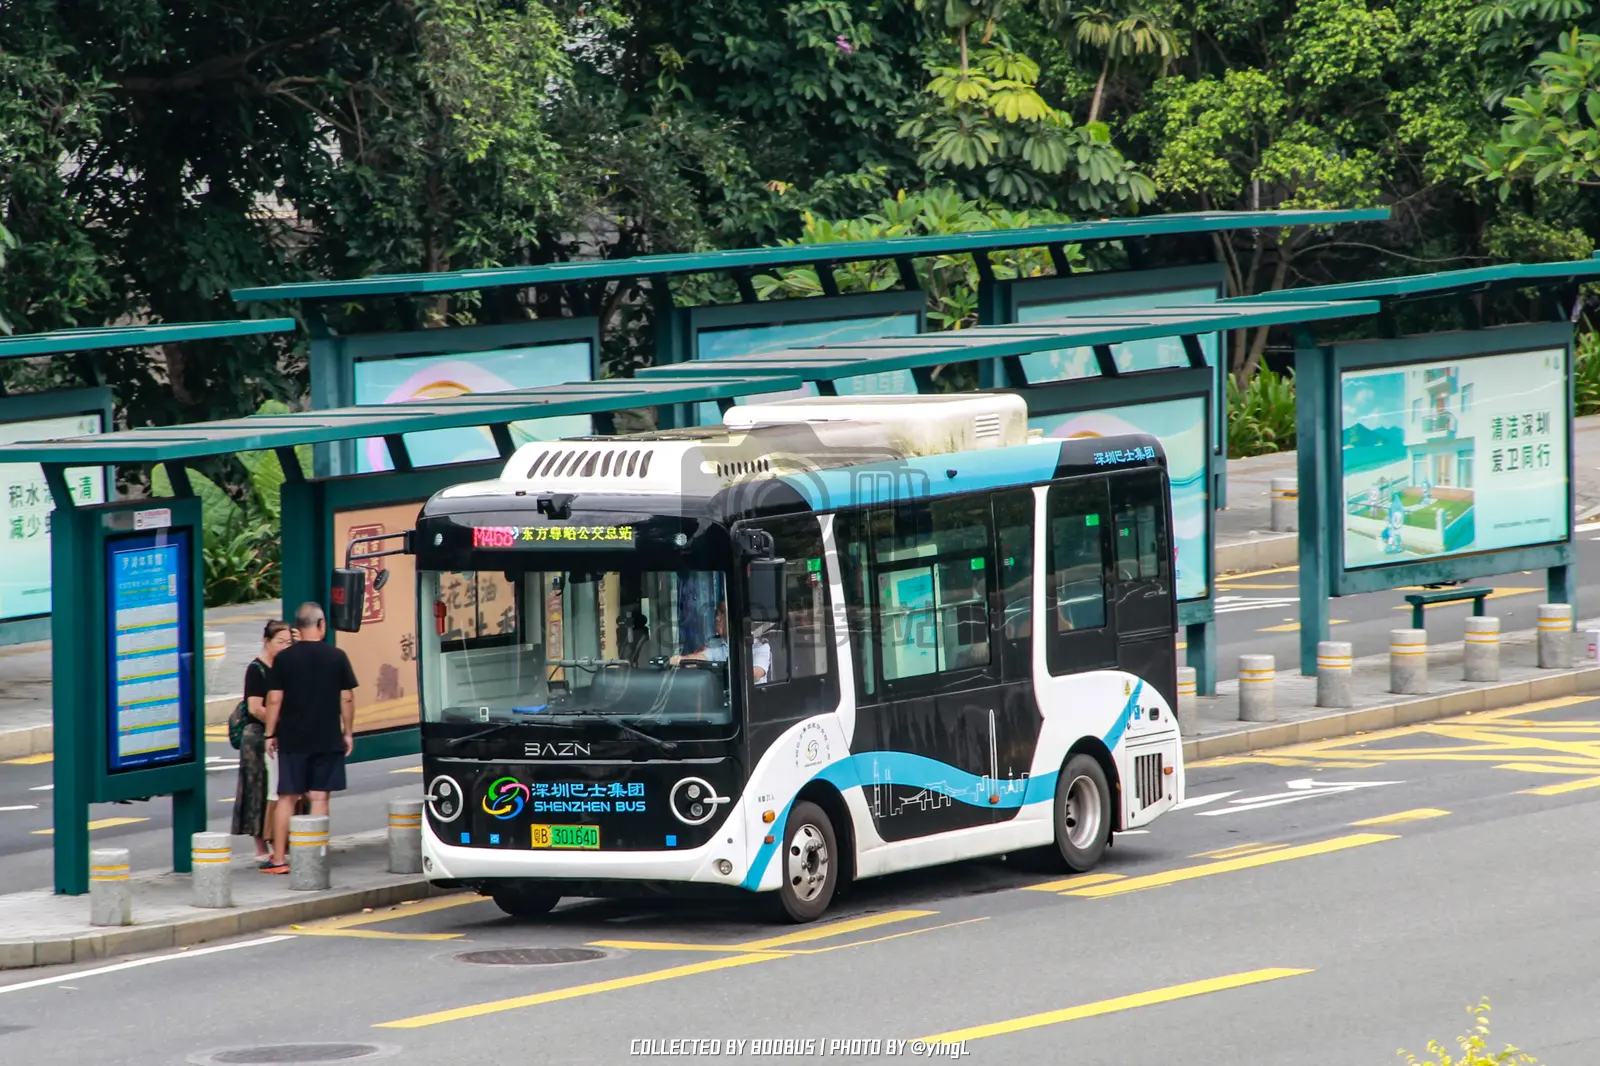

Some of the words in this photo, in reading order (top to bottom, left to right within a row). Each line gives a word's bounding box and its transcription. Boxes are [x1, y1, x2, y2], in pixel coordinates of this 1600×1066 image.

[1491, 411, 1550, 440] 清洁深圳
[1093, 446, 1155, 466] 深圳巴士集团
[1492, 443, 1550, 472] 爱卫同行
[473, 526, 514, 547] M468
[524, 743, 591, 756] BAZN
[531, 782, 645, 798] 深圳巴士集团
[534, 801, 611, 812] SHENZHEN
[615, 801, 646, 812] BUS
